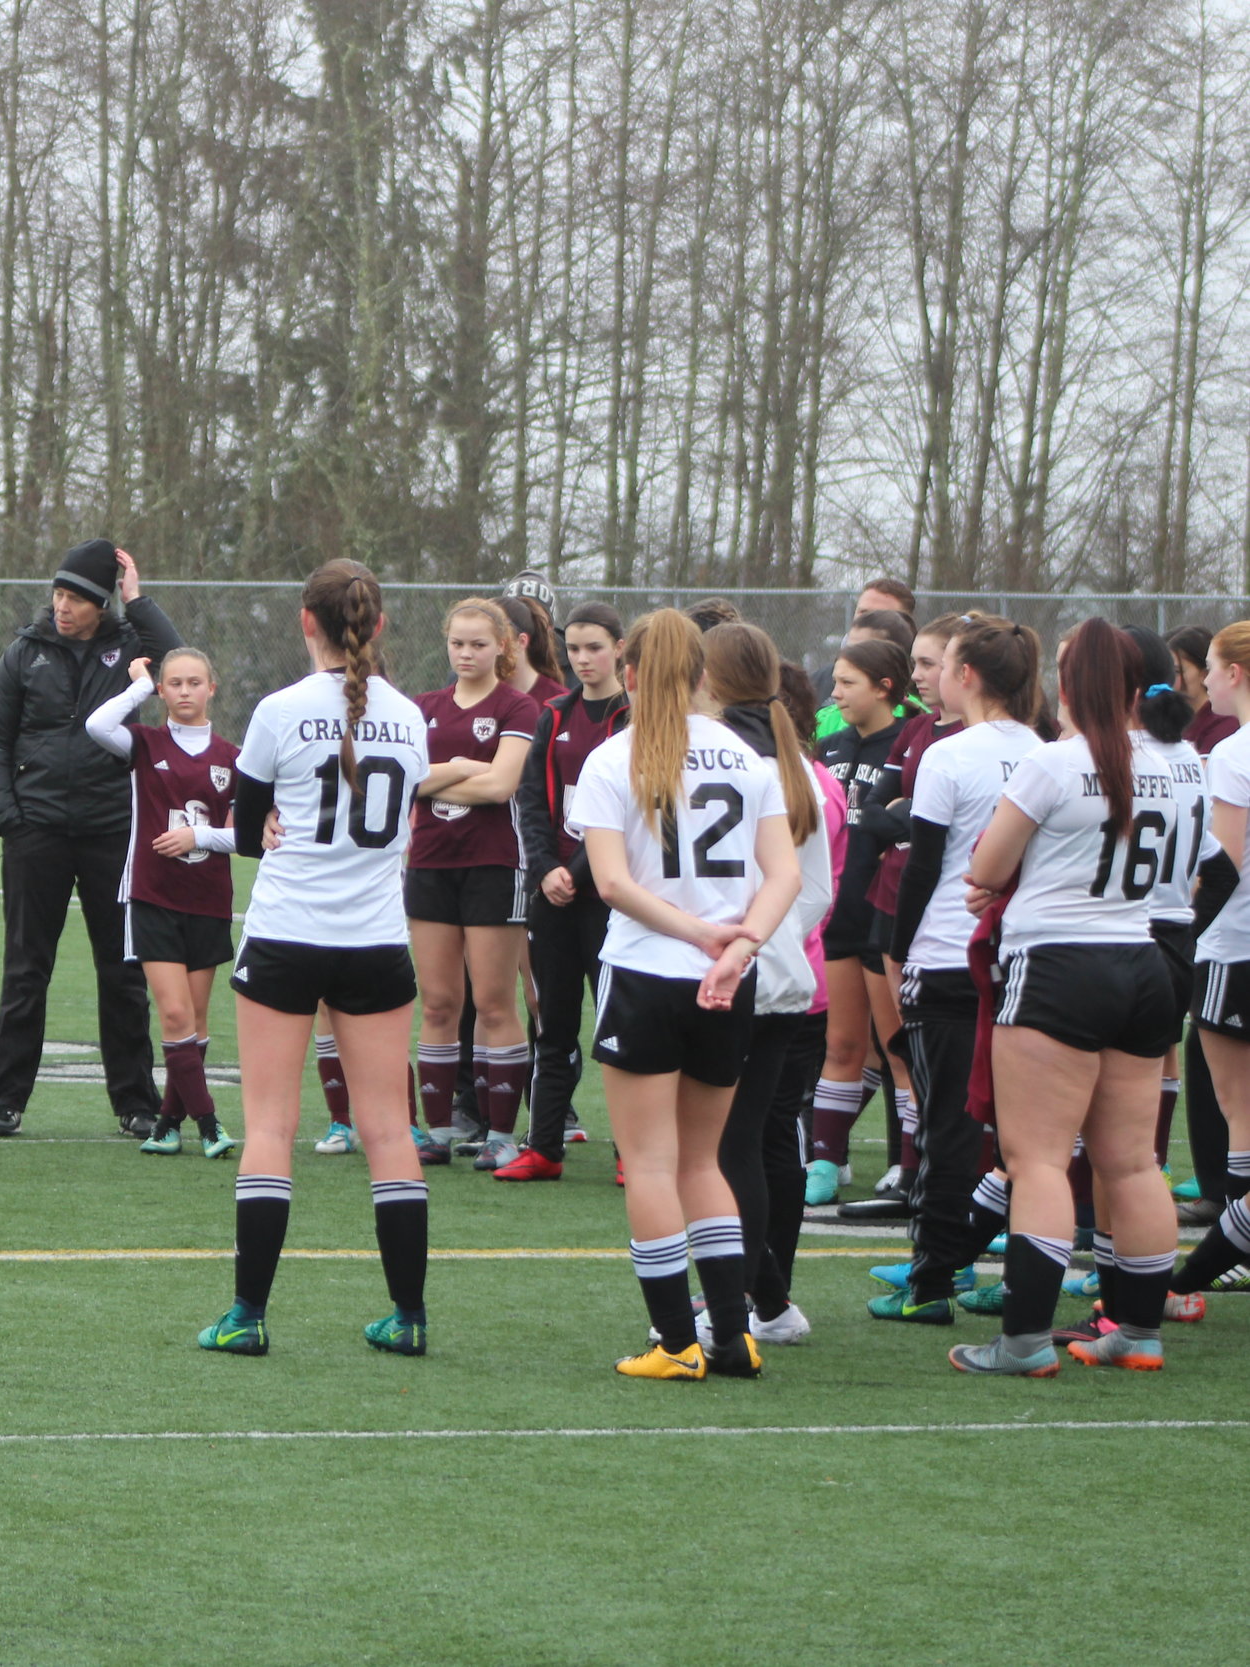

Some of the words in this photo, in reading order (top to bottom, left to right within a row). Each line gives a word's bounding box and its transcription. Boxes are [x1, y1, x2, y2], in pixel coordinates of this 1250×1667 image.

[298, 718, 415, 747] CRANDALL
[681, 748, 749, 772] SUCH
[314, 754, 406, 849] 10
[854, 763, 885, 786] ISLA
[653, 782, 746, 878] 12
[1088, 810, 1167, 901] 16
